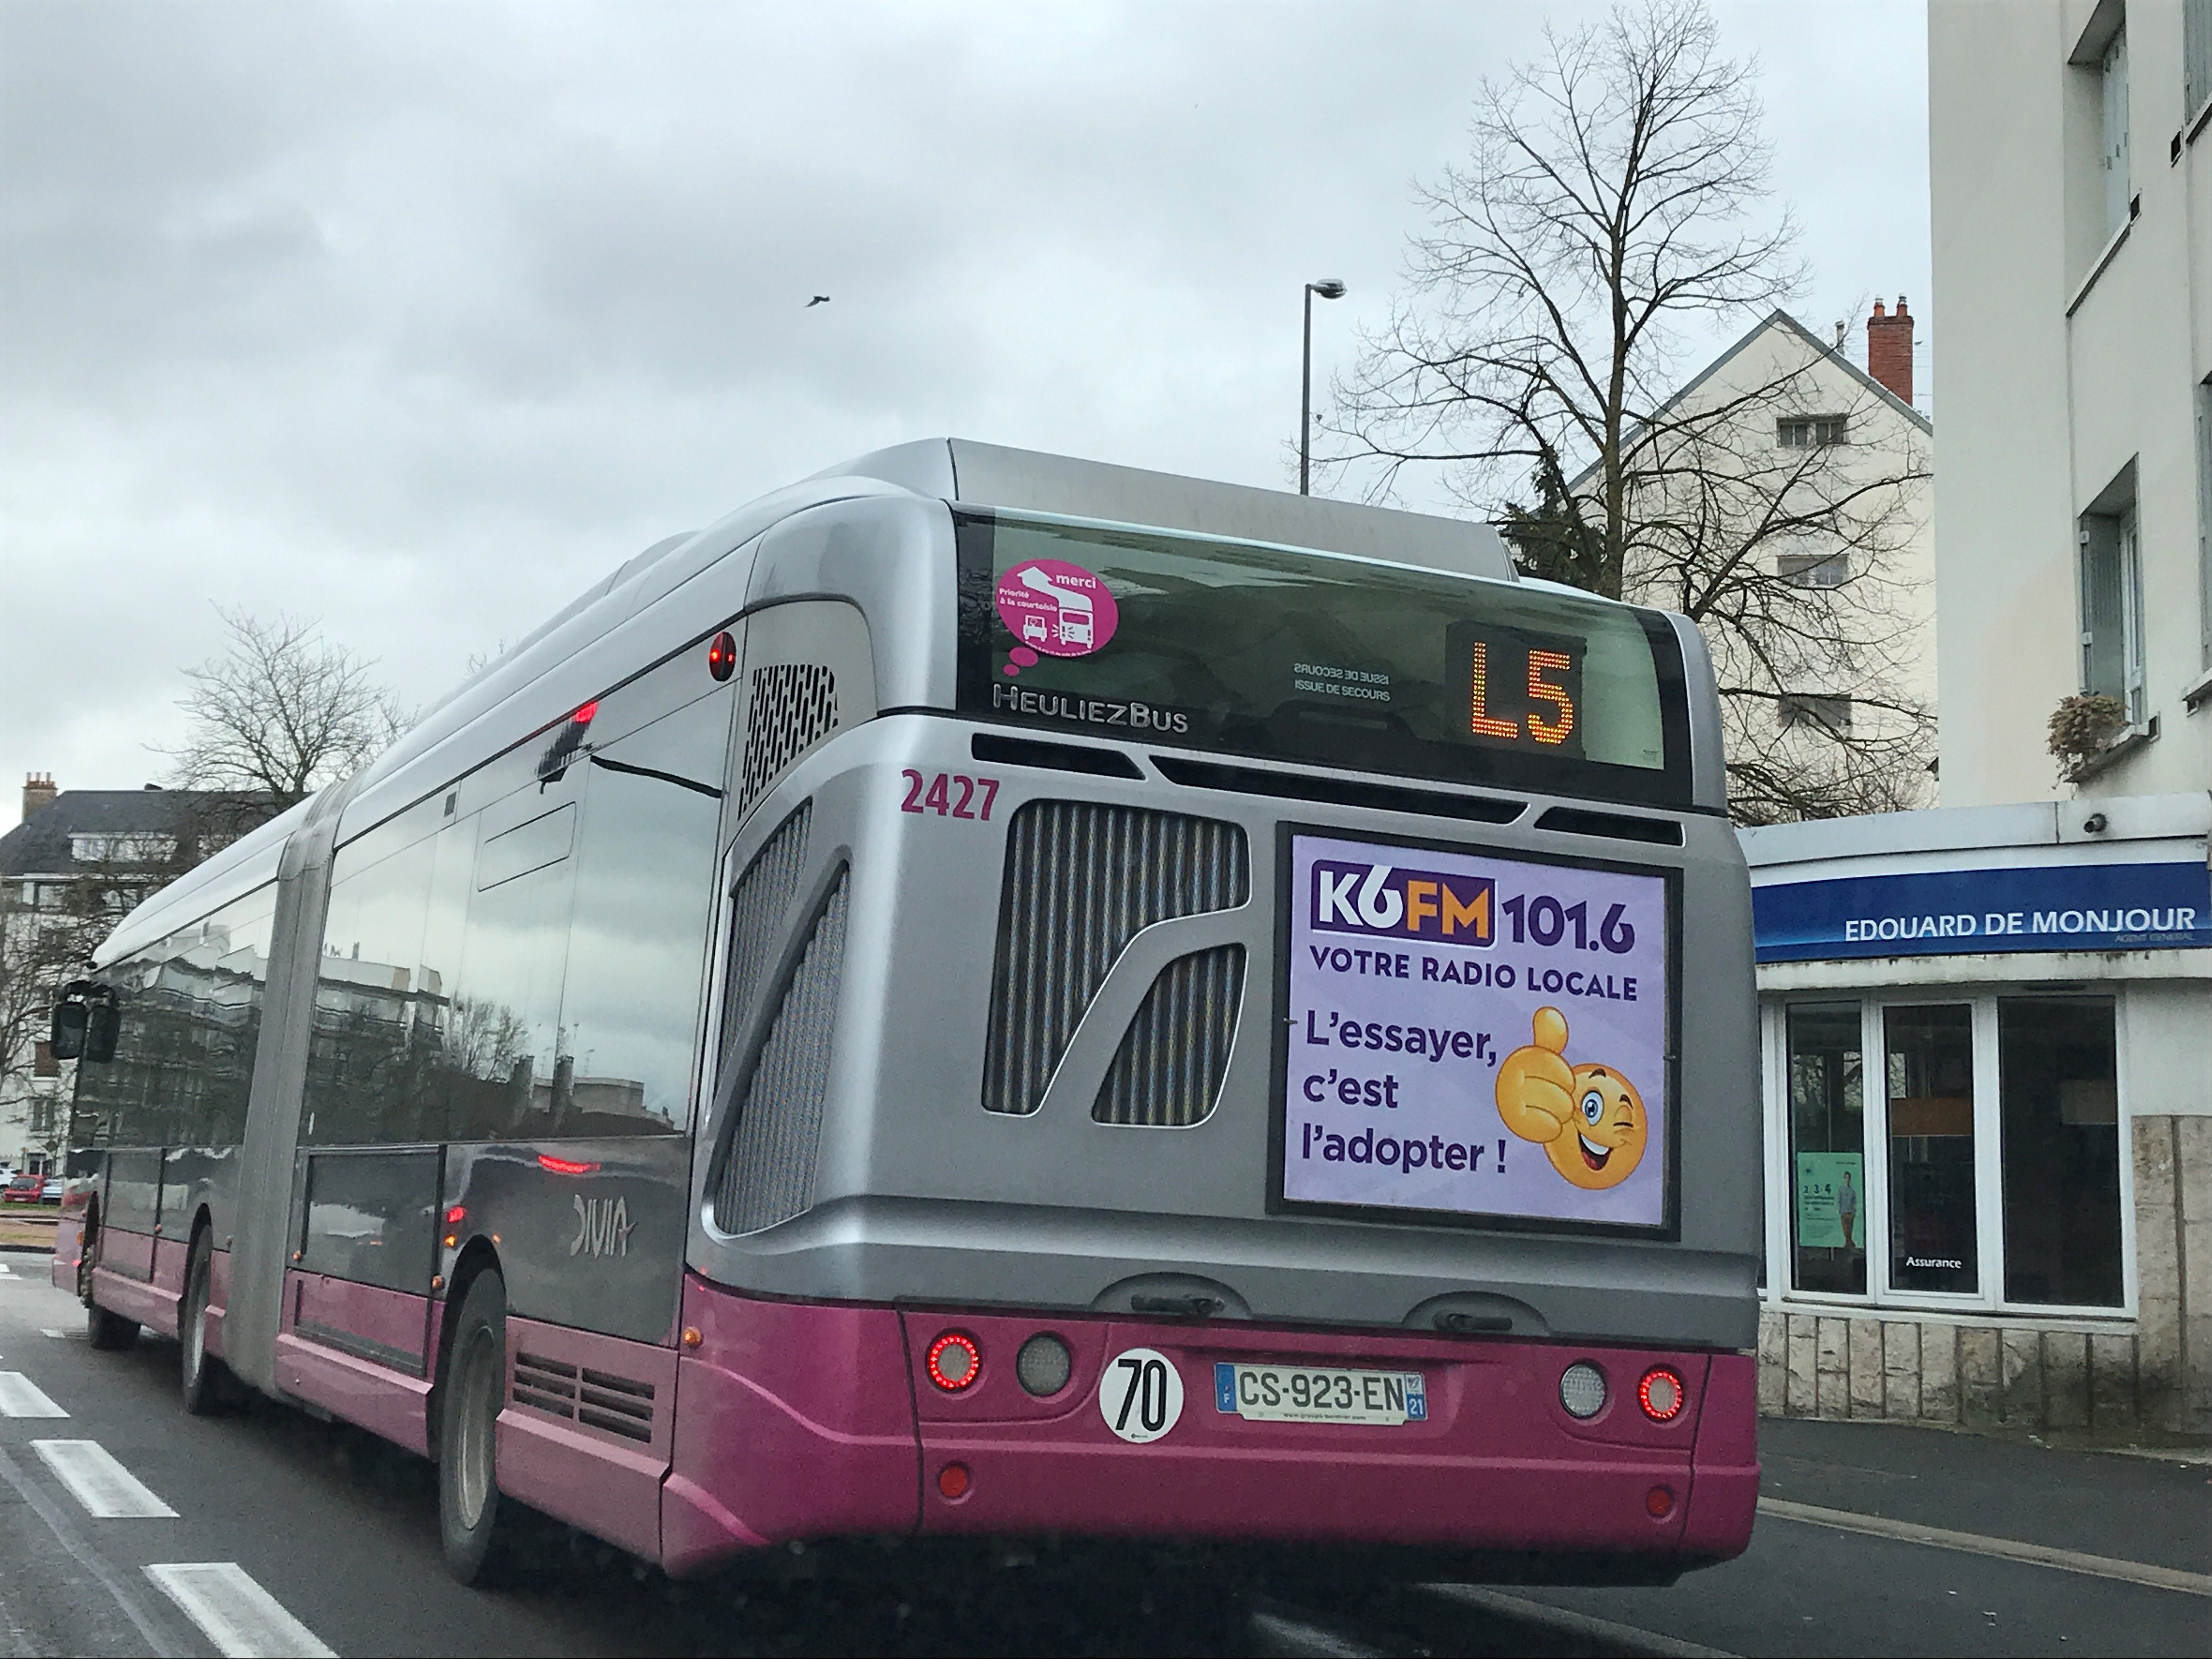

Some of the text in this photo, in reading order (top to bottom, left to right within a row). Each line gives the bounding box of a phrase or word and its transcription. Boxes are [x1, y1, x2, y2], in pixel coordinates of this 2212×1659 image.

[1007, 597, 1015, 606] la
[1017, 601, 1058, 612] courtoisie
[1056, 573, 1097, 589] merci
[1295, 679, 1391, 702] ISSUE DE SECOURS
[1472, 641, 1574, 746] L5
[901, 769, 1000, 821] 2427
[1502, 894, 1635, 953] 101.6
[1844, 907, 2196, 942] EDOUARD DE MONJOUR
[1310, 945, 1638, 1002] VOTRE RADIO LOCALE
[1307, 1009, 1498, 1068] L’essayer,
[1303, 1069, 1399, 1108] c’est
[1302, 1122, 1507, 1173] l’adopter !
[1906, 1256, 1962, 1269] Assurance
[1115, 1358, 1167, 1432] 70
[1239, 1372, 1405, 1412] CS-923-EN
[1409, 1398, 1424, 1415] 21
